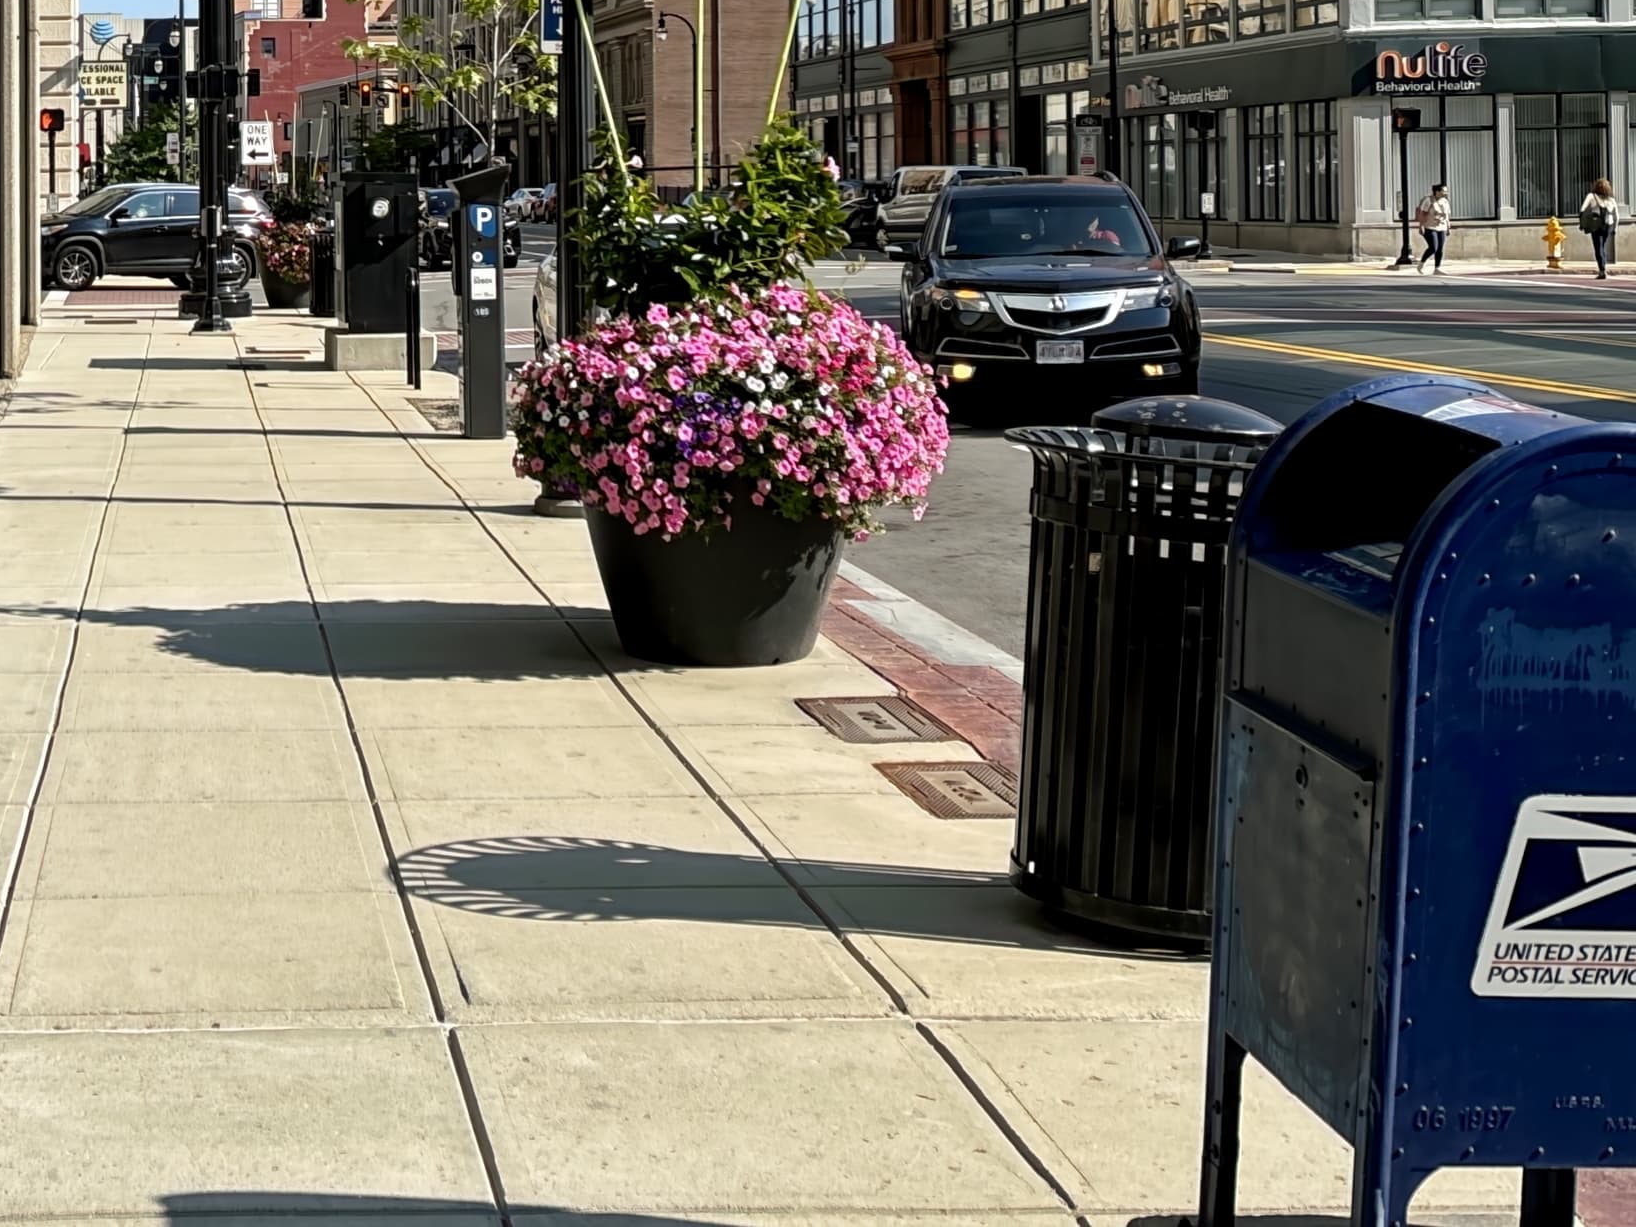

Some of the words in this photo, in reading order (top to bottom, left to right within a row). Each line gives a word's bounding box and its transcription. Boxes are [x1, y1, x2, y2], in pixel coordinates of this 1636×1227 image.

[95, 76, 124, 85] SPACE
[1375, 81, 1436, 92] Behavioral
[1168, 88, 1204, 106] Behavioral
[247, 125, 268, 135] ONE
[247, 137, 268, 146] WAY
[476, 207, 493, 232] P
[1494, 943, 1574, 961] UNITED
[1487, 966, 1566, 984] POSTAL
[1414, 1104, 1447, 1132] 06
[1459, 1104, 1517, 1132] 1997
